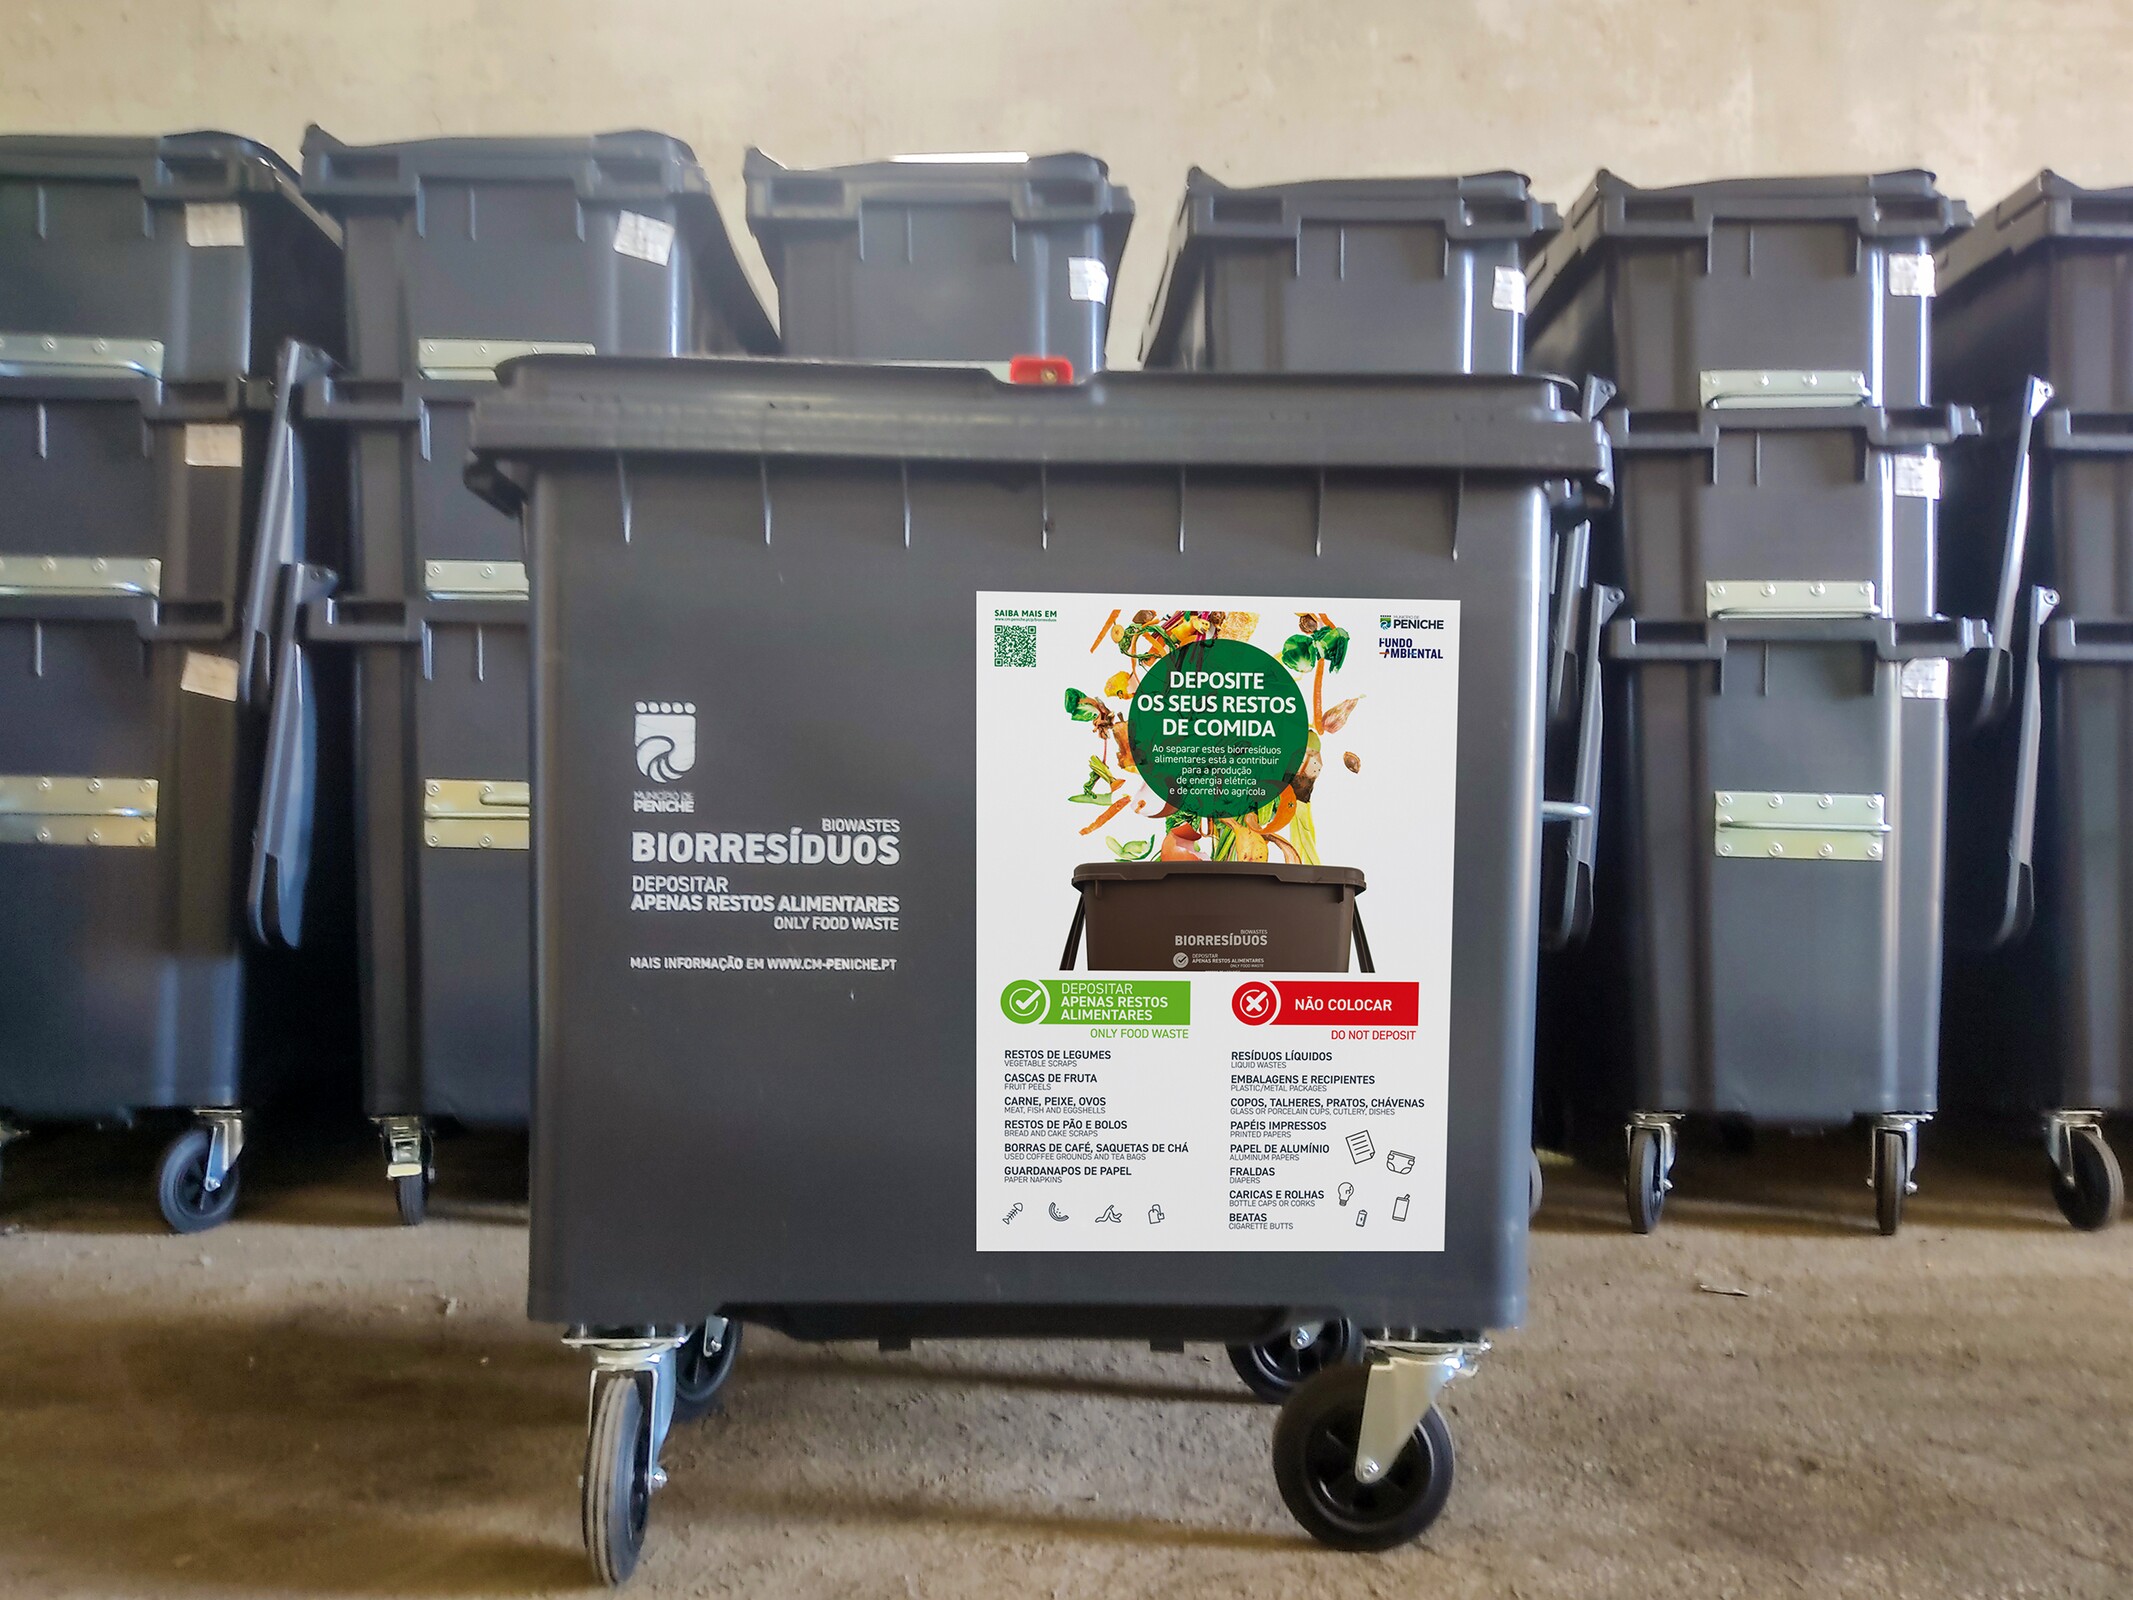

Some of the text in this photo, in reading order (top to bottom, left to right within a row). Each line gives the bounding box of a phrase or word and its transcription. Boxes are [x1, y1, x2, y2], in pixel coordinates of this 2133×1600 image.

[1393, 620, 1444, 629] PENICHE
[1379, 638, 1412, 647] FUNDO
[1379, 649, 1443, 658] AMBIENTAL
[1170, 672, 1264, 689] DEPOSITE
[1138, 695, 1297, 713] OS SEUS RESTOS
[1162, 719, 1276, 737] DE COMIDA
[1228, 746, 1281, 754] biorresíduos
[1155, 755, 1206, 763] alimentares
[1209, 756, 1226, 764] está
[1237, 756, 1279, 764] contribuir
[1211, 767, 1252, 776] produção
[1177, 776, 1256, 786] de energia elétrica
[1190, 787, 1229, 795] corretivo
[1232, 787, 1266, 797] agrícola
[633, 800, 694, 813] PENICHE
[822, 818, 900, 833] BIOWASTES
[632, 827, 900, 865] BIORRESÍDUOS
[632, 875, 729, 893] DEPOSITAR
[631, 894, 900, 913] APENAS RESTOS ALIMENTARES
[774, 916, 899, 931] ONLY FOOD WASTE
[1175, 933, 1268, 945] BIORRESÍDUOS
[630, 955, 897, 971] MAIS INFORMAÇÃO EM WWW.CM-PENICHE.PT
[1061, 983, 1133, 994] DEPOSITAR
[1061, 996, 1168, 1008] APENAS RESTOS
[1295, 996, 1392, 1011] NÃO COLOCAR
[1061, 1010, 1152, 1021] ALIMENTARES
[1090, 1028, 1189, 1039] ONLY FOOD WASTE
[1331, 1030, 1416, 1040] DO NOT DEPOSIT
[1004, 1050, 1111, 1060] RESTOS DE LEGUMES
[1231, 1050, 1332, 1061] RESÍDUOS LÍQUIDOS
[1004, 1073, 1097, 1083] CASCAS DE FRUTA
[1231, 1075, 1375, 1084] EMBALAGENS E RECIPIENTES
[1004, 1097, 1106, 1107] CARNE, PEIXE, OVOS
[1231, 1097, 1425, 1108] COPOS, TALHERES, PRATOS, CHÁVENAS
[1004, 1118, 1127, 1130] RESTOS DE PÃO E BOLOS
[1230, 1119, 1327, 1131] PAPÉIS IMPRESSOS
[1004, 1142, 1189, 1153] BORRAS DE CAFÉ, SAQUETAS DE CHÁ
[1230, 1143, 1329, 1153] PAPEL DE ALUMÍNIO
[1004, 1167, 1132, 1176] GUARDANAPOS DE PAPEL
[1230, 1167, 1275, 1176] FRALDAS
[1229, 1190, 1324, 1199] CARICAS E ROLHAS
[1229, 1213, 1267, 1222] BEATAS
